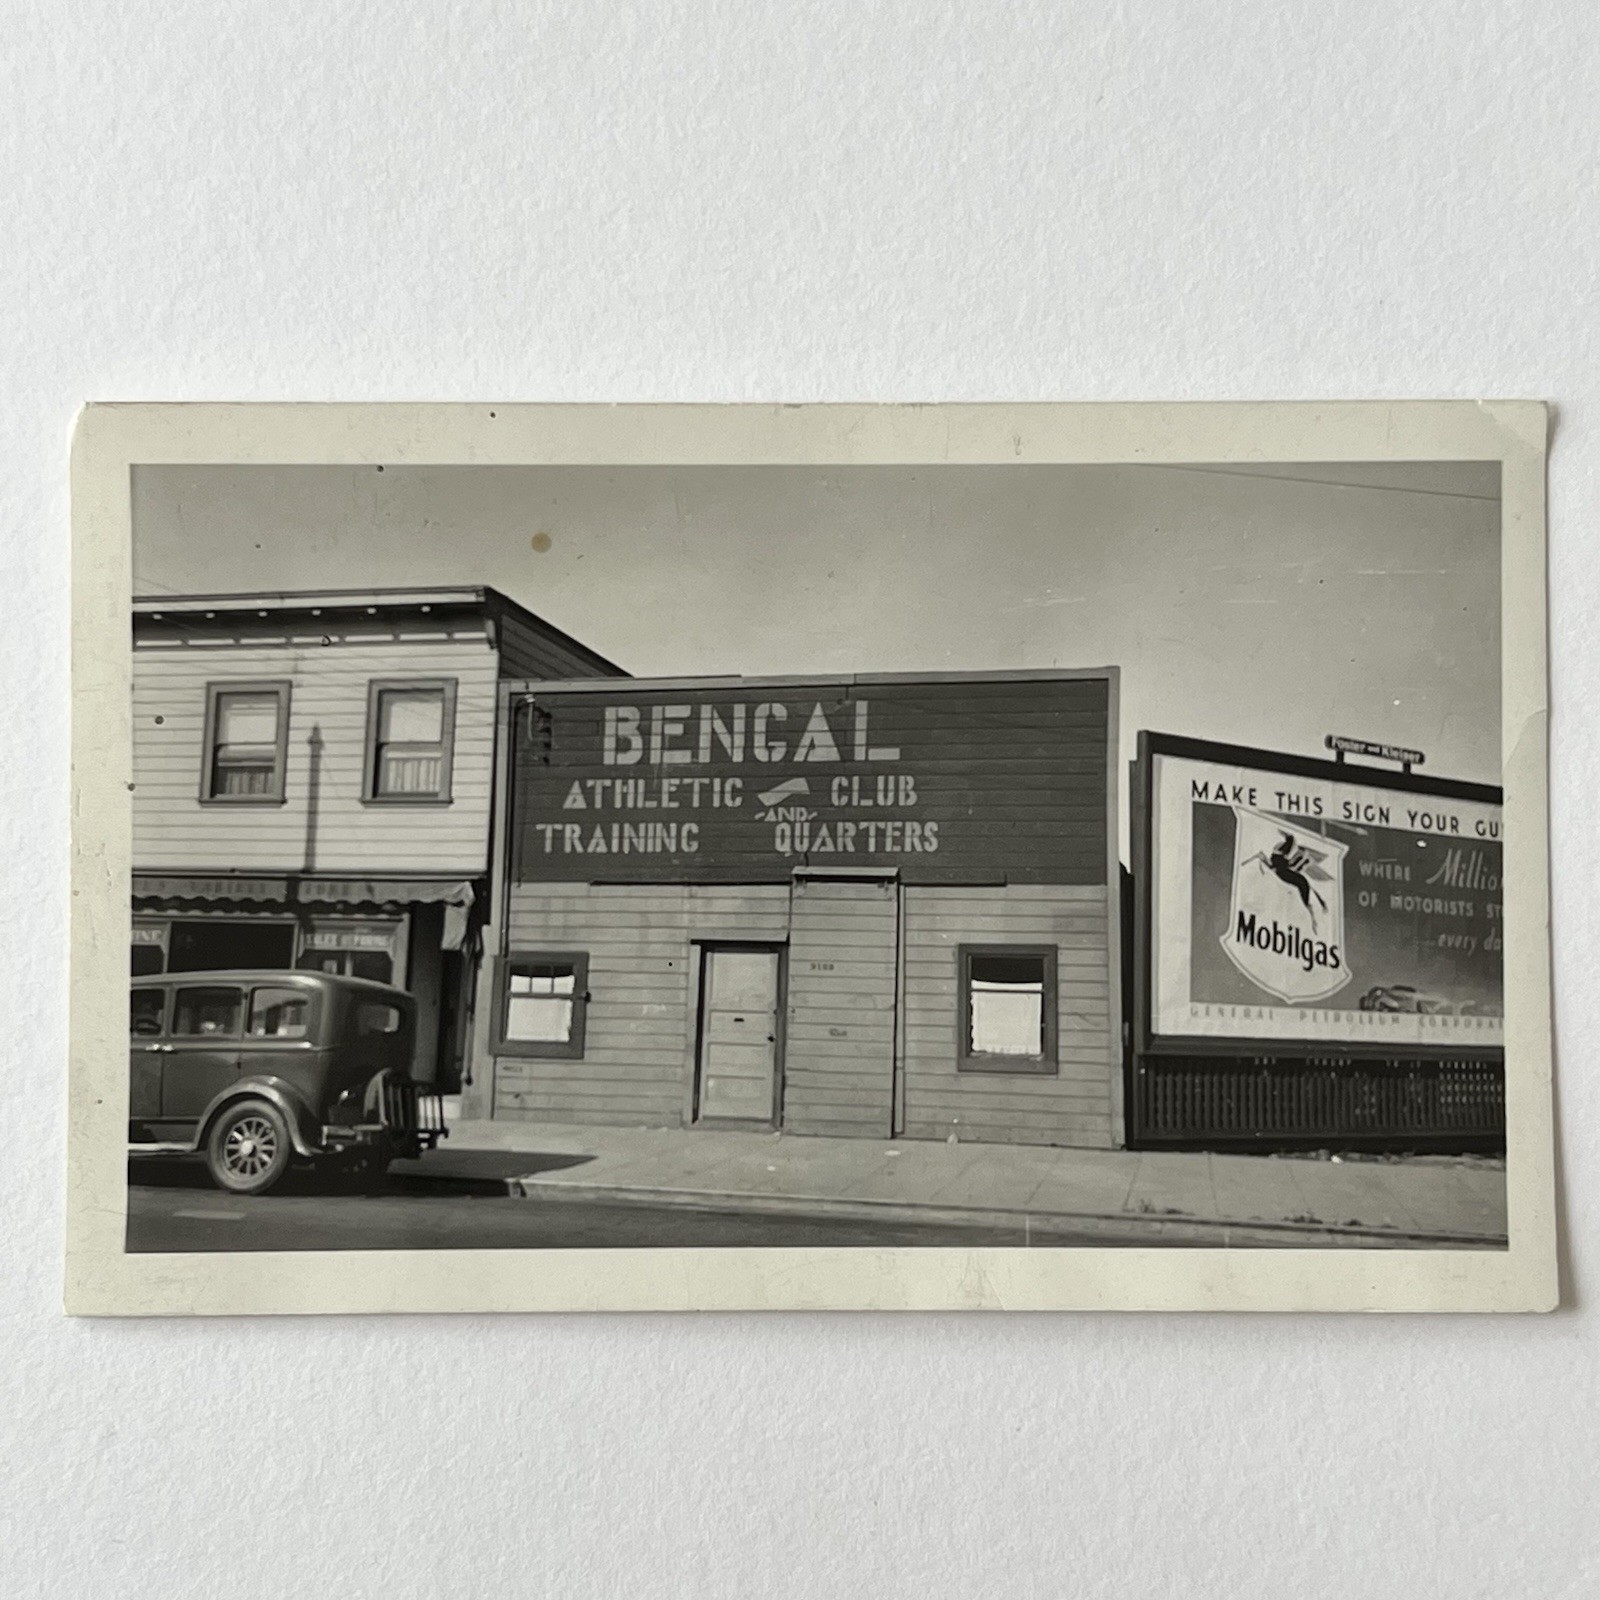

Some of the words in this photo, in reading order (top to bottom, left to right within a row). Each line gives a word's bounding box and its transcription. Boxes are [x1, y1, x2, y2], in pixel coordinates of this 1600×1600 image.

[602, 699, 901, 765] BENGAL
[562, 777, 744, 810] ATHLETIC
[830, 774, 918, 807] CLUB
[1191, 779, 1258, 806] MAKE
[1275, 791, 1324, 815] THIS
[1342, 801, 1391, 824] SIGN
[1406, 810, 1460, 834] YOUR
[1475, 819, 1503, 838] GU
[536, 822, 700, 854] TRAINING
[774, 821, 940, 857] QUARTERS
[1359, 860, 1411, 882] WHERE
[1425, 848, 1503, 891] Millio
[1358, 891, 1378, 908] OF
[1390, 894, 1474, 917] MOTORISTS
[1236, 910, 1340, 971] Mobilgas
[1438, 932, 1477, 956] every
